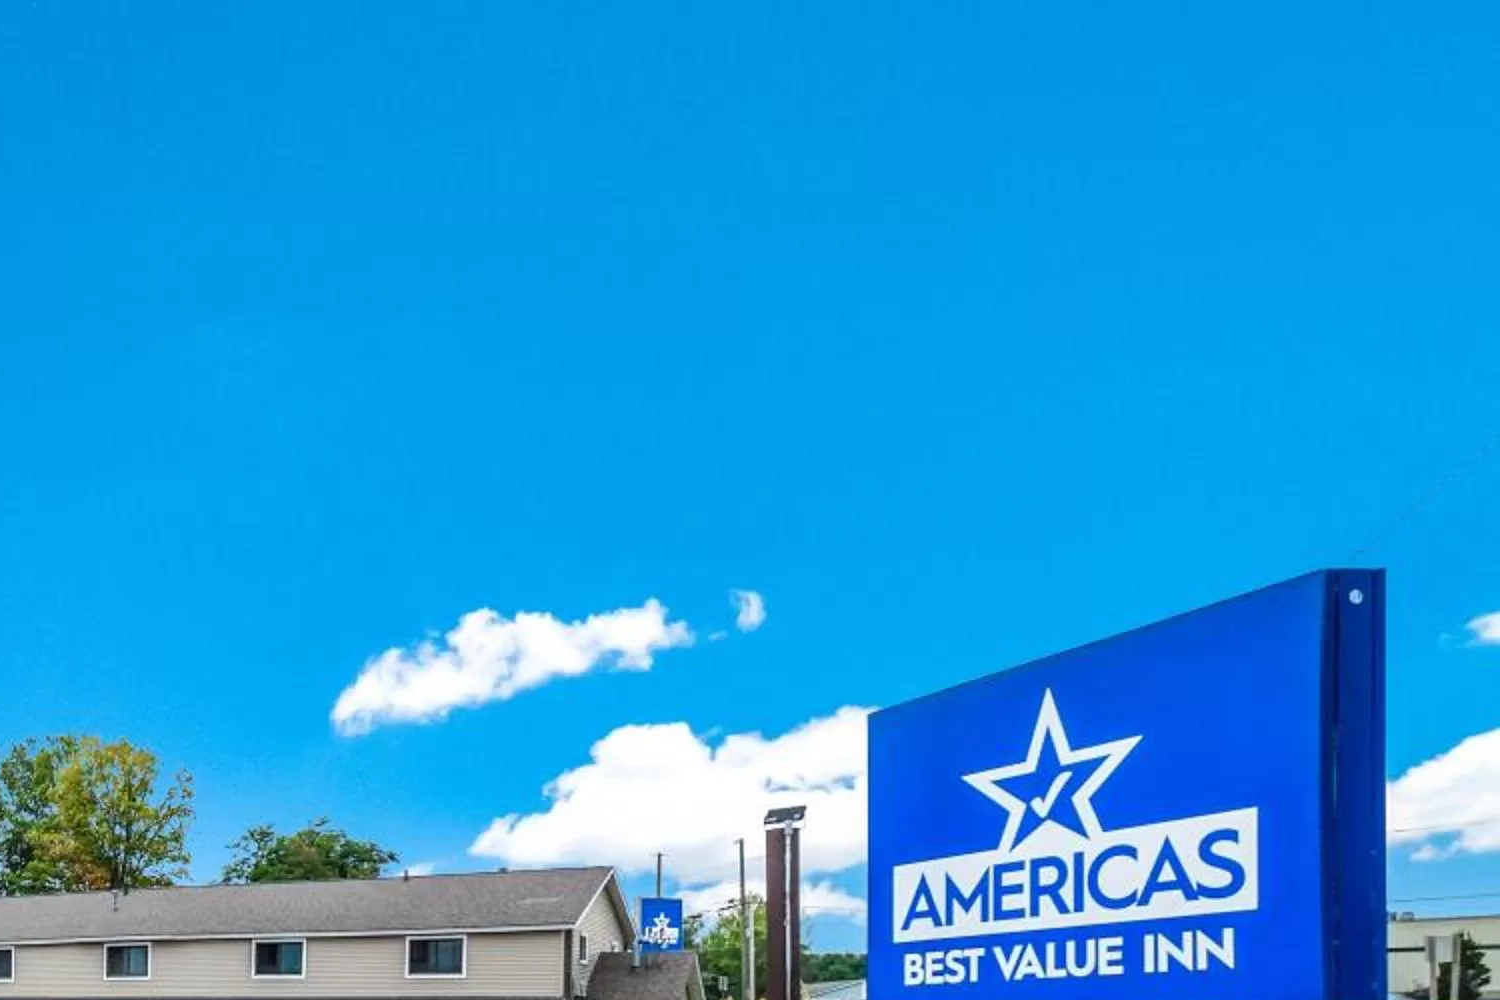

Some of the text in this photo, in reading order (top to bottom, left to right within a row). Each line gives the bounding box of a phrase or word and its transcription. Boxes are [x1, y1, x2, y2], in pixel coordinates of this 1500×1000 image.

[900, 828, 1247, 931] AMERICAS
[903, 927, 1235, 986] BEST VALUE INN
